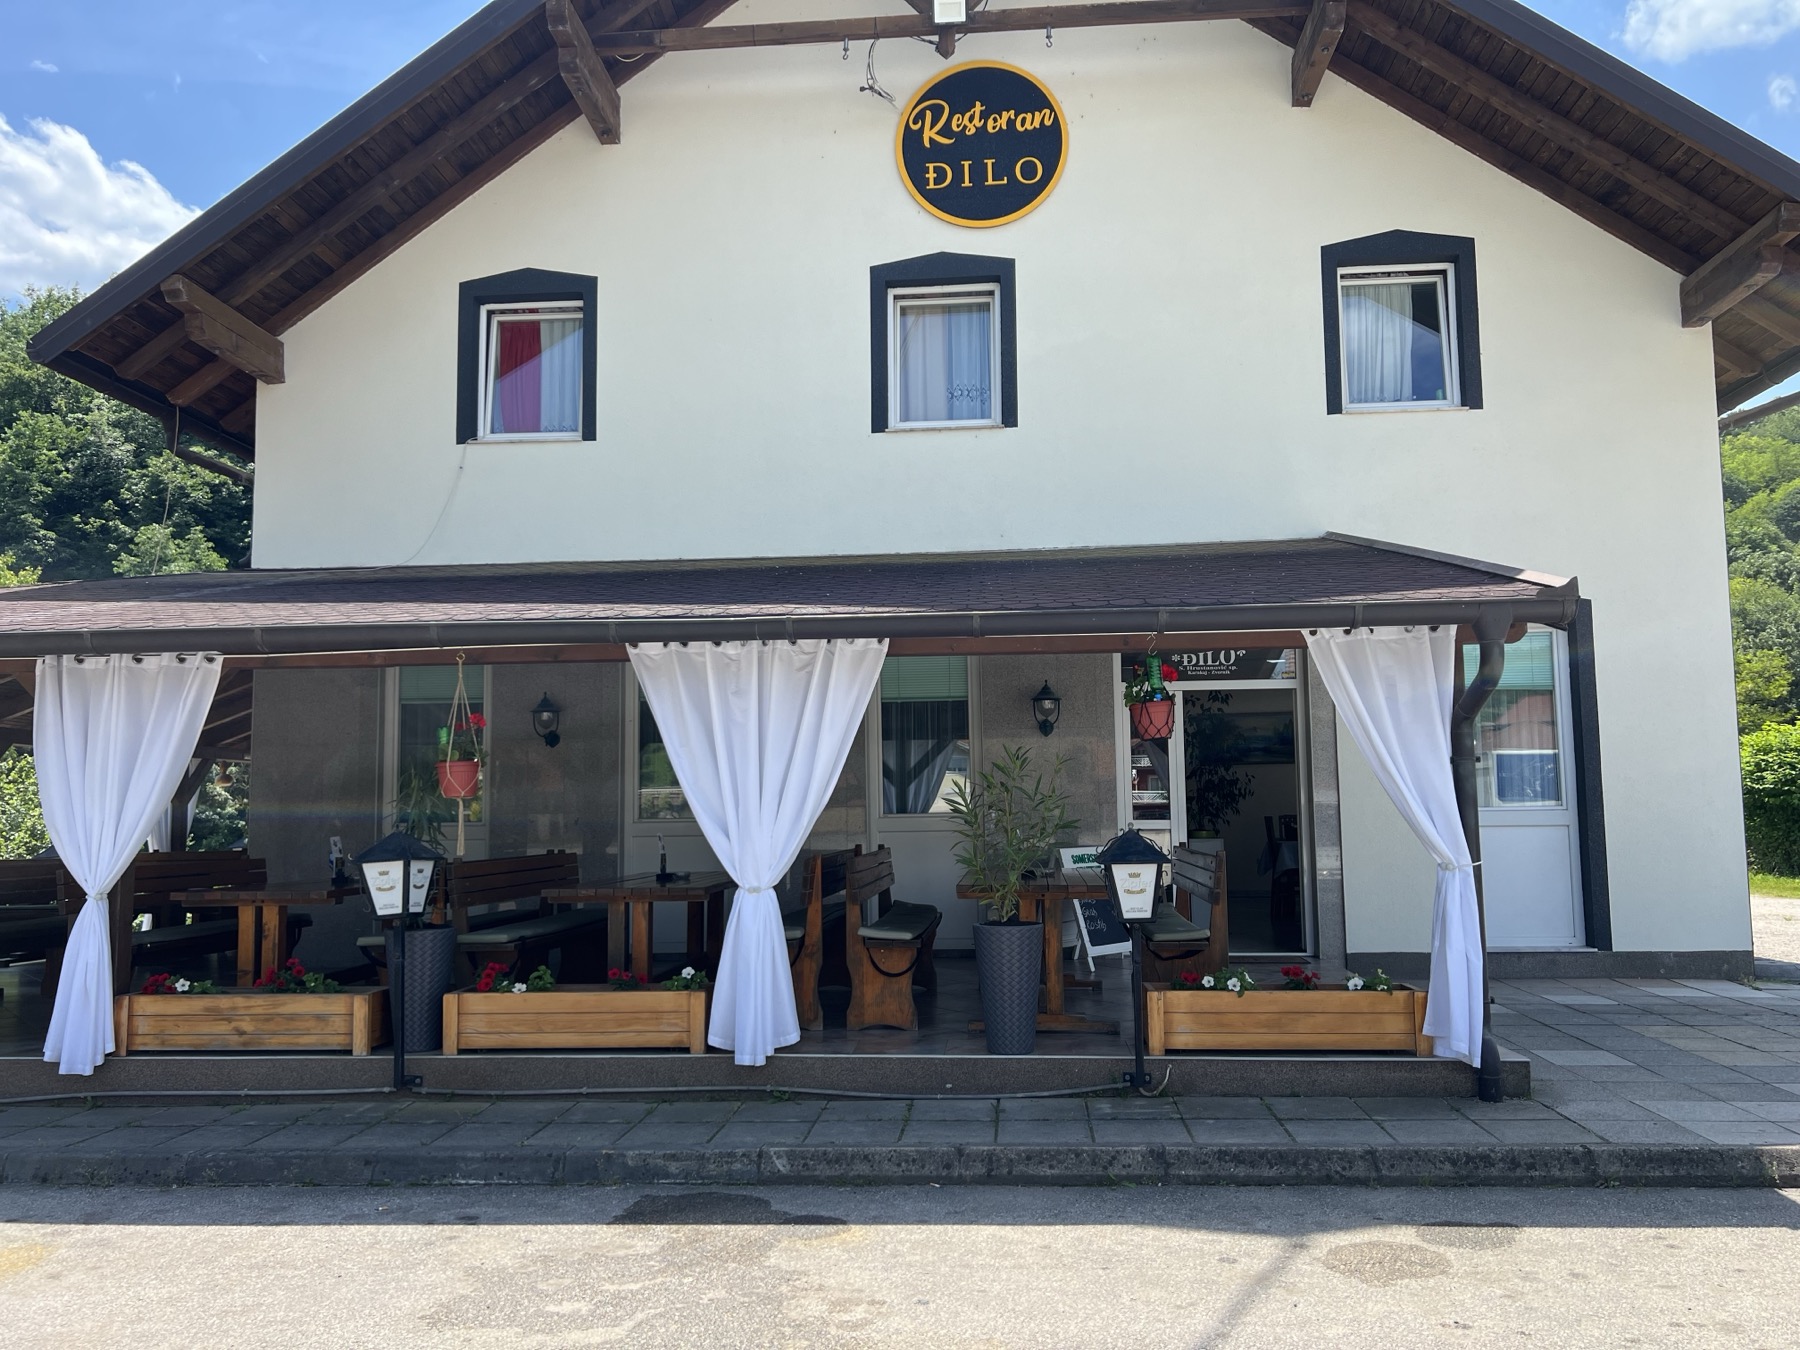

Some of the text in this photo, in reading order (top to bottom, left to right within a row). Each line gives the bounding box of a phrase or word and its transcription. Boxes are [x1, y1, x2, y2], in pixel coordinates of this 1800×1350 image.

[908, 99, 1054, 148] Restoran
[925, 157, 1043, 189] ĐILO
[1071, 853, 1098, 865] SOMERS
